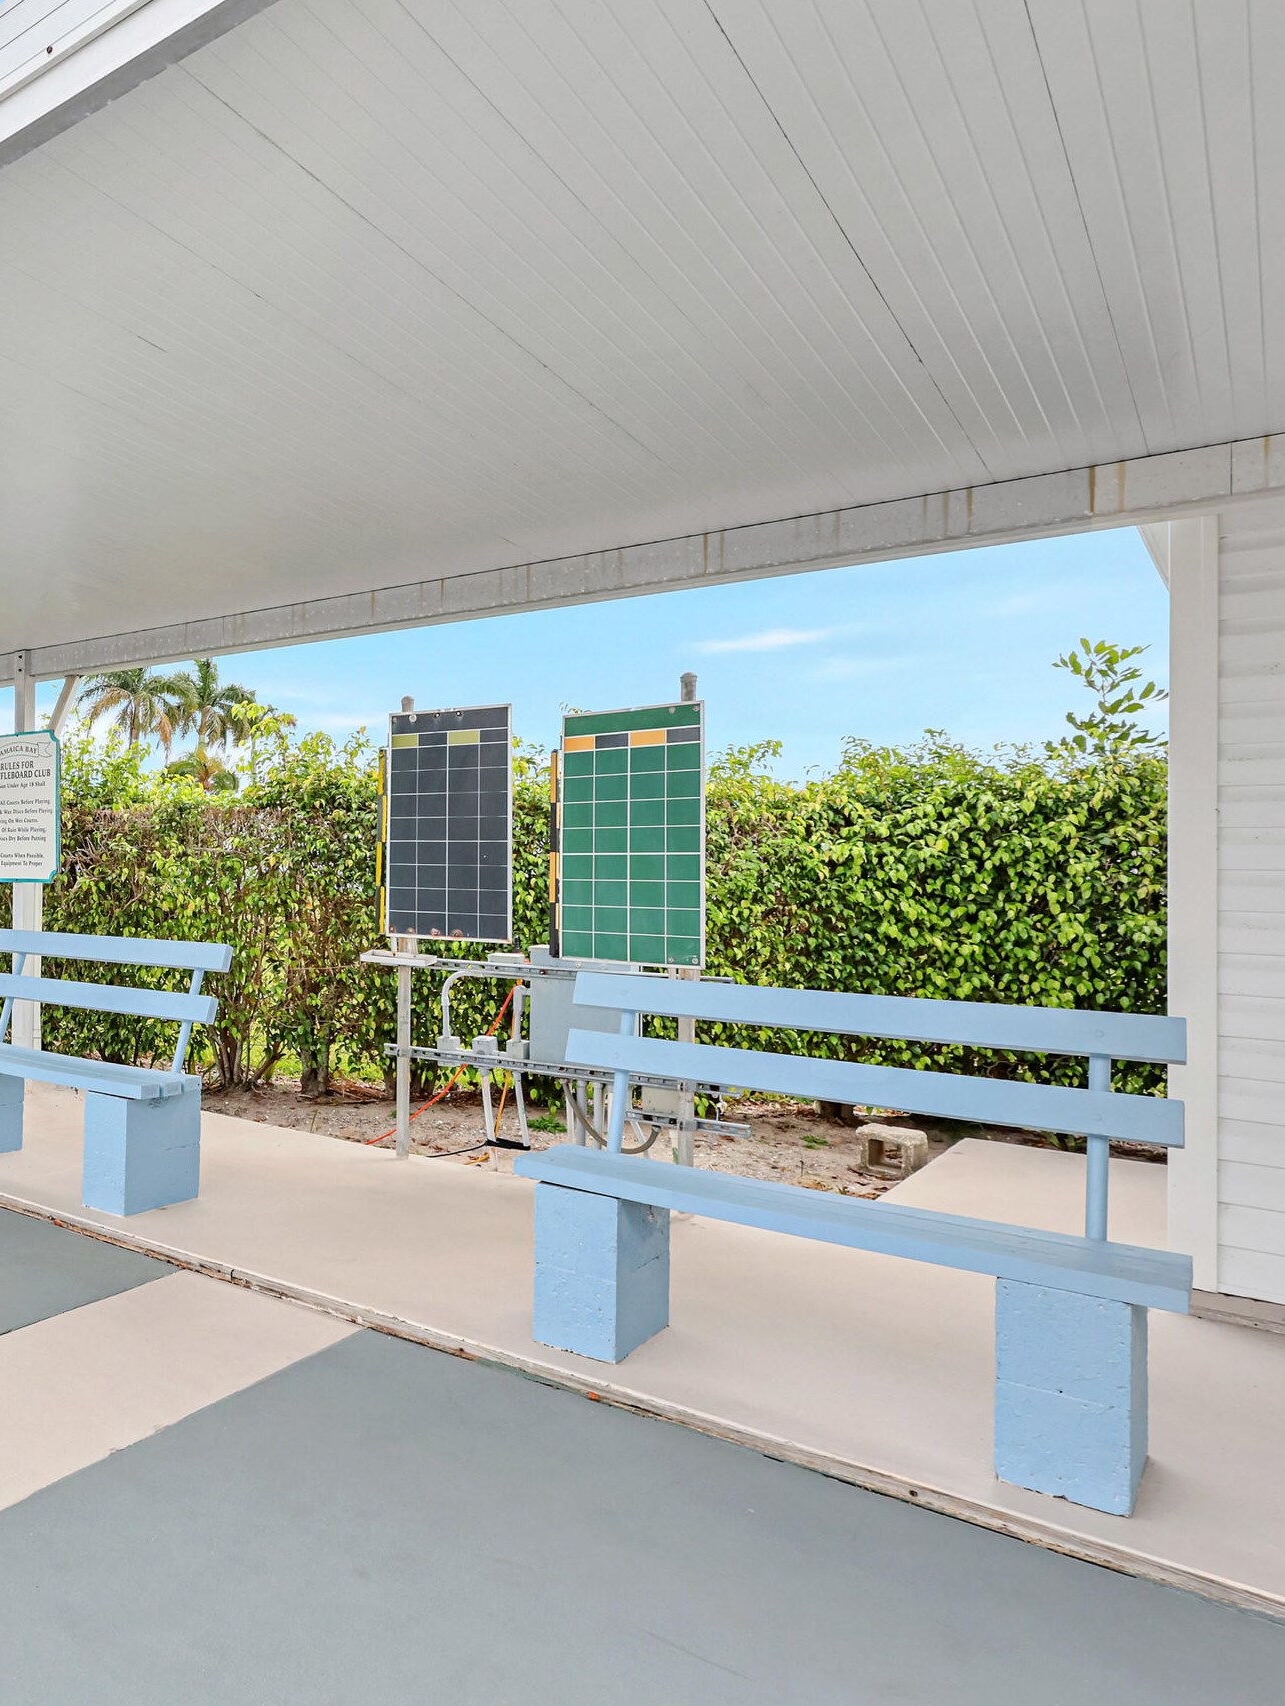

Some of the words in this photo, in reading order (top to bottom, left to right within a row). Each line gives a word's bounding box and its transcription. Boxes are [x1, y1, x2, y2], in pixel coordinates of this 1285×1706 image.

[25, 746, 38, 754] BAY
[0, 761, 20, 771] RULES
[21, 760, 34, 769] FOR
[34, 769, 51, 777] CLUB
[1, 860, 22, 868] Equipment
[29, 860, 43, 868] Proper
